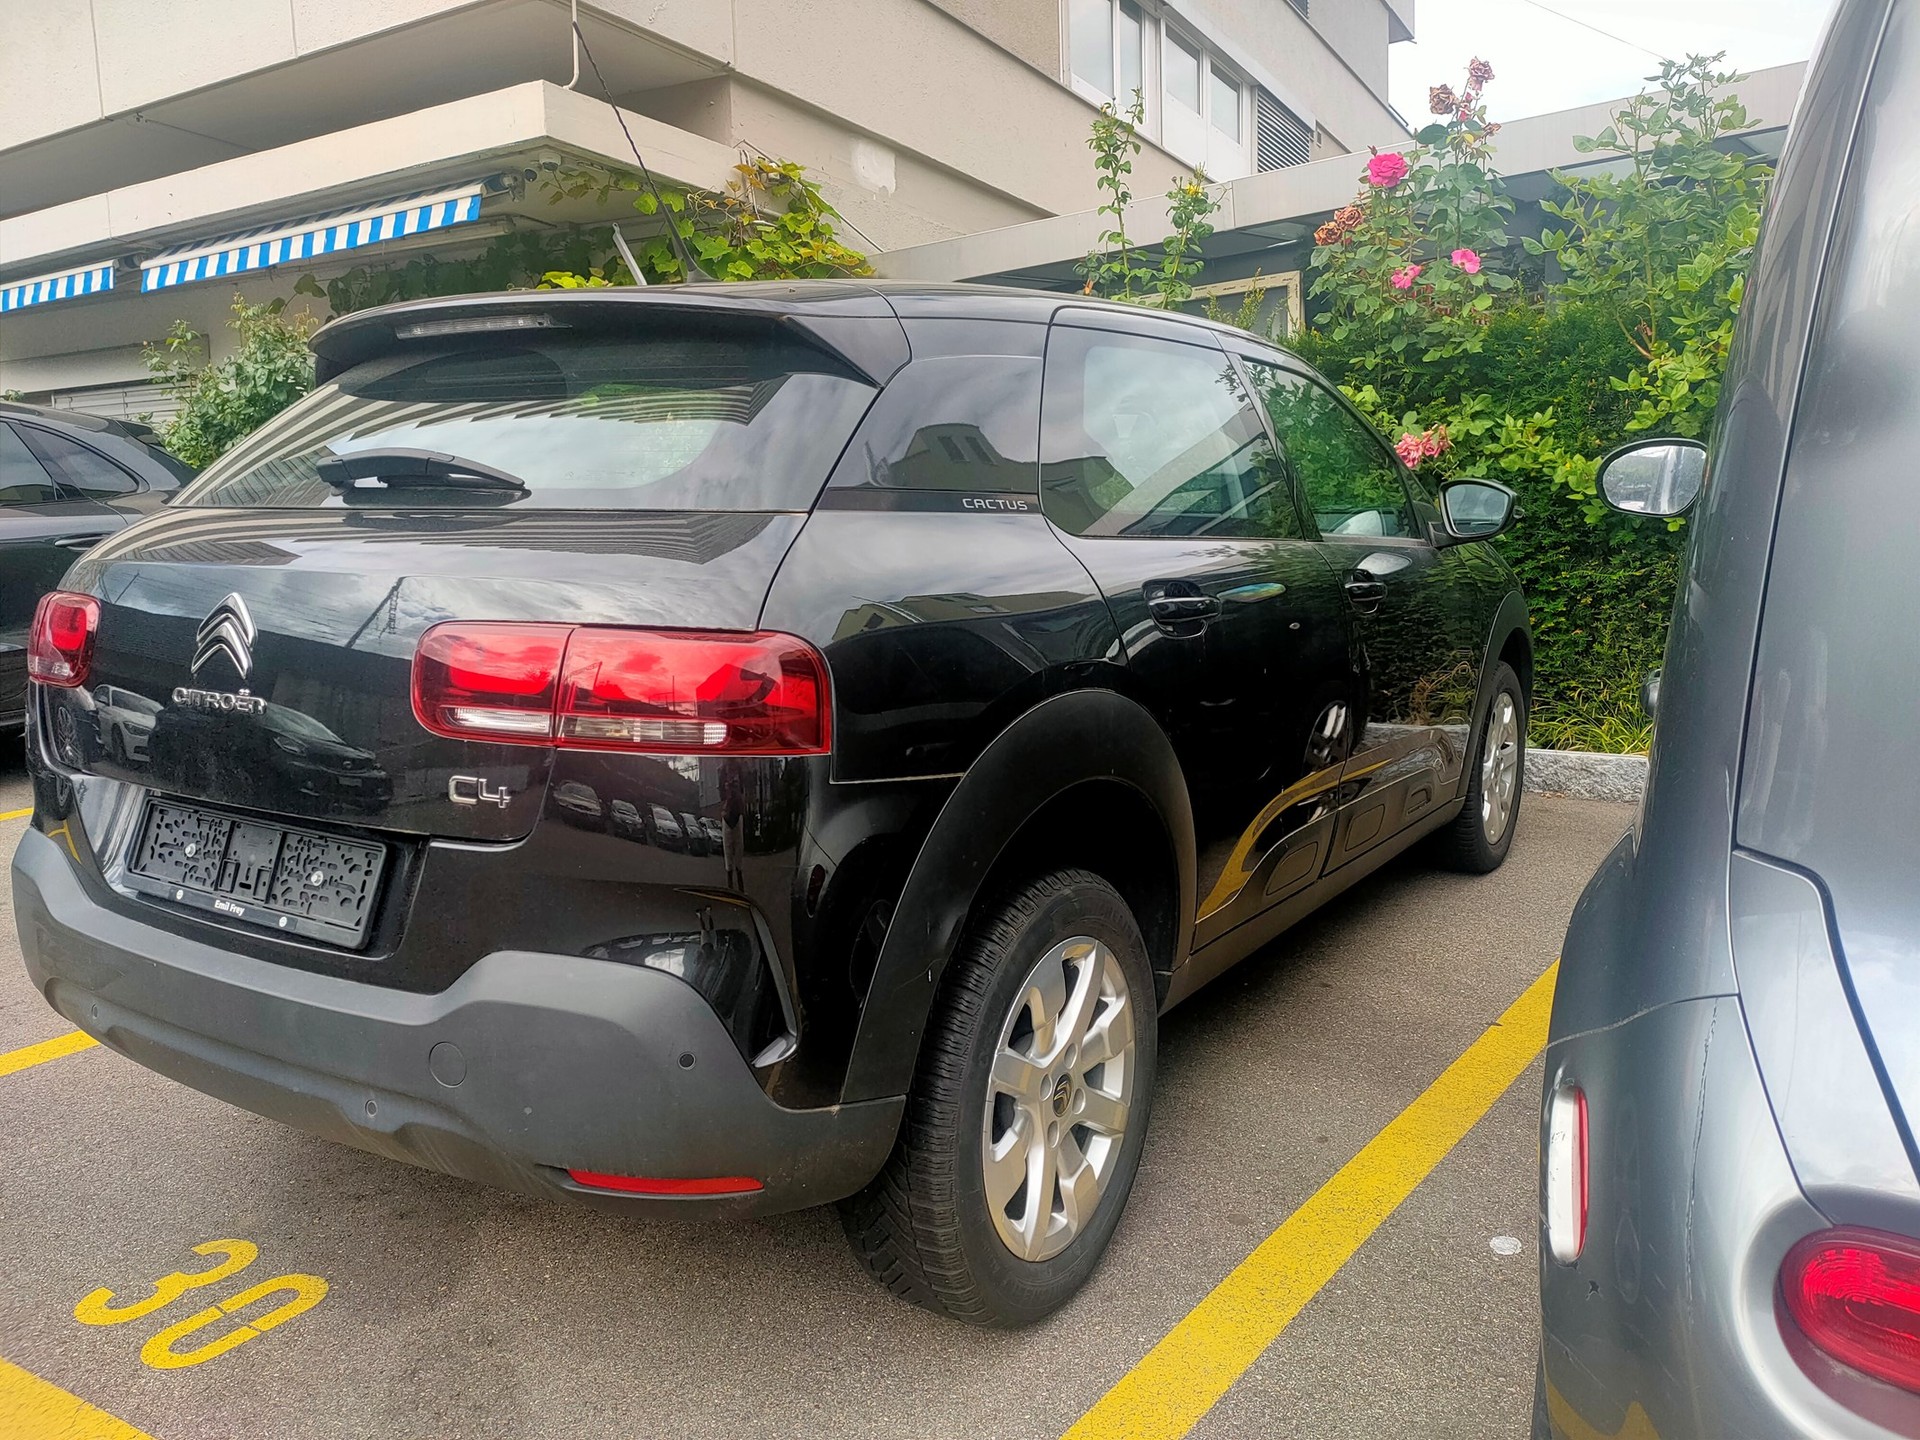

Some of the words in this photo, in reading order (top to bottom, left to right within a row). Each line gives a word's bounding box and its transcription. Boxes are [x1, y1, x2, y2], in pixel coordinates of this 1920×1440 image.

[962, 498, 1028, 511] CACTUS
[448, 775, 512, 809] C4
[214, 899, 230, 911] Emil
[229, 903, 246, 917] Frey
[73, 1238, 329, 1369] 30
